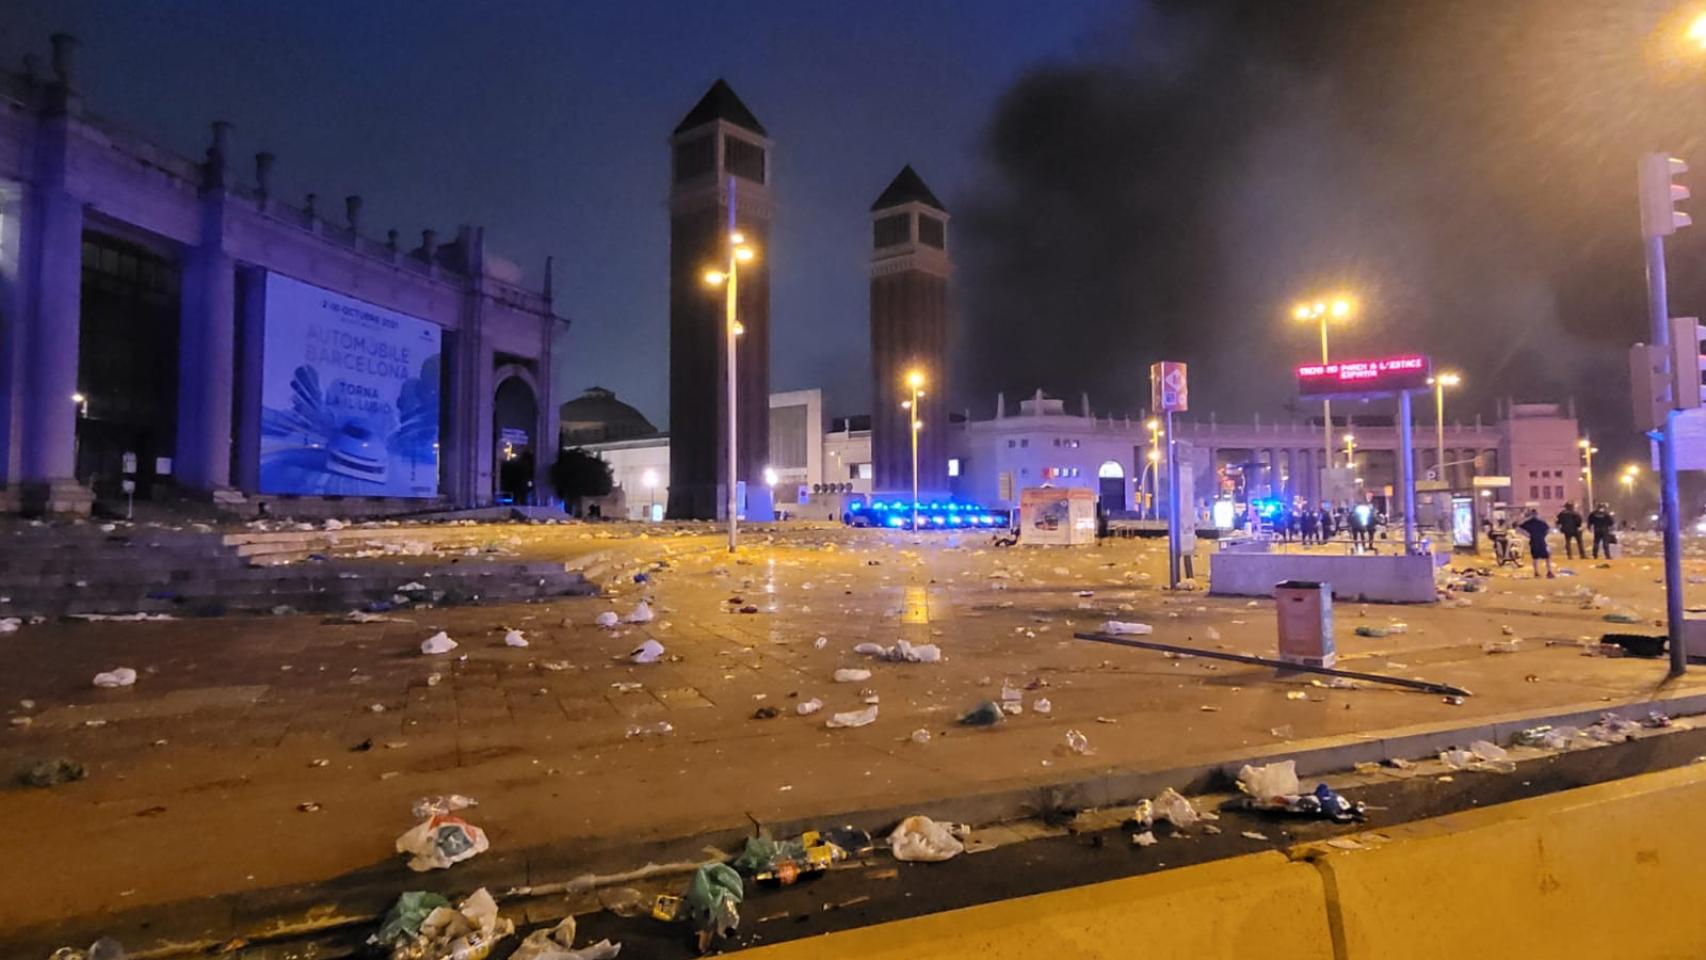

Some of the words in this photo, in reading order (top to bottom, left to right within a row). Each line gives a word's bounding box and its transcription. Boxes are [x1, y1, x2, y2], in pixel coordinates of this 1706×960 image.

[305, 343, 409, 379] BARCELONA
[306, 323, 410, 364] AUTOMOBILE
[339, 381, 378, 398] TORNA
